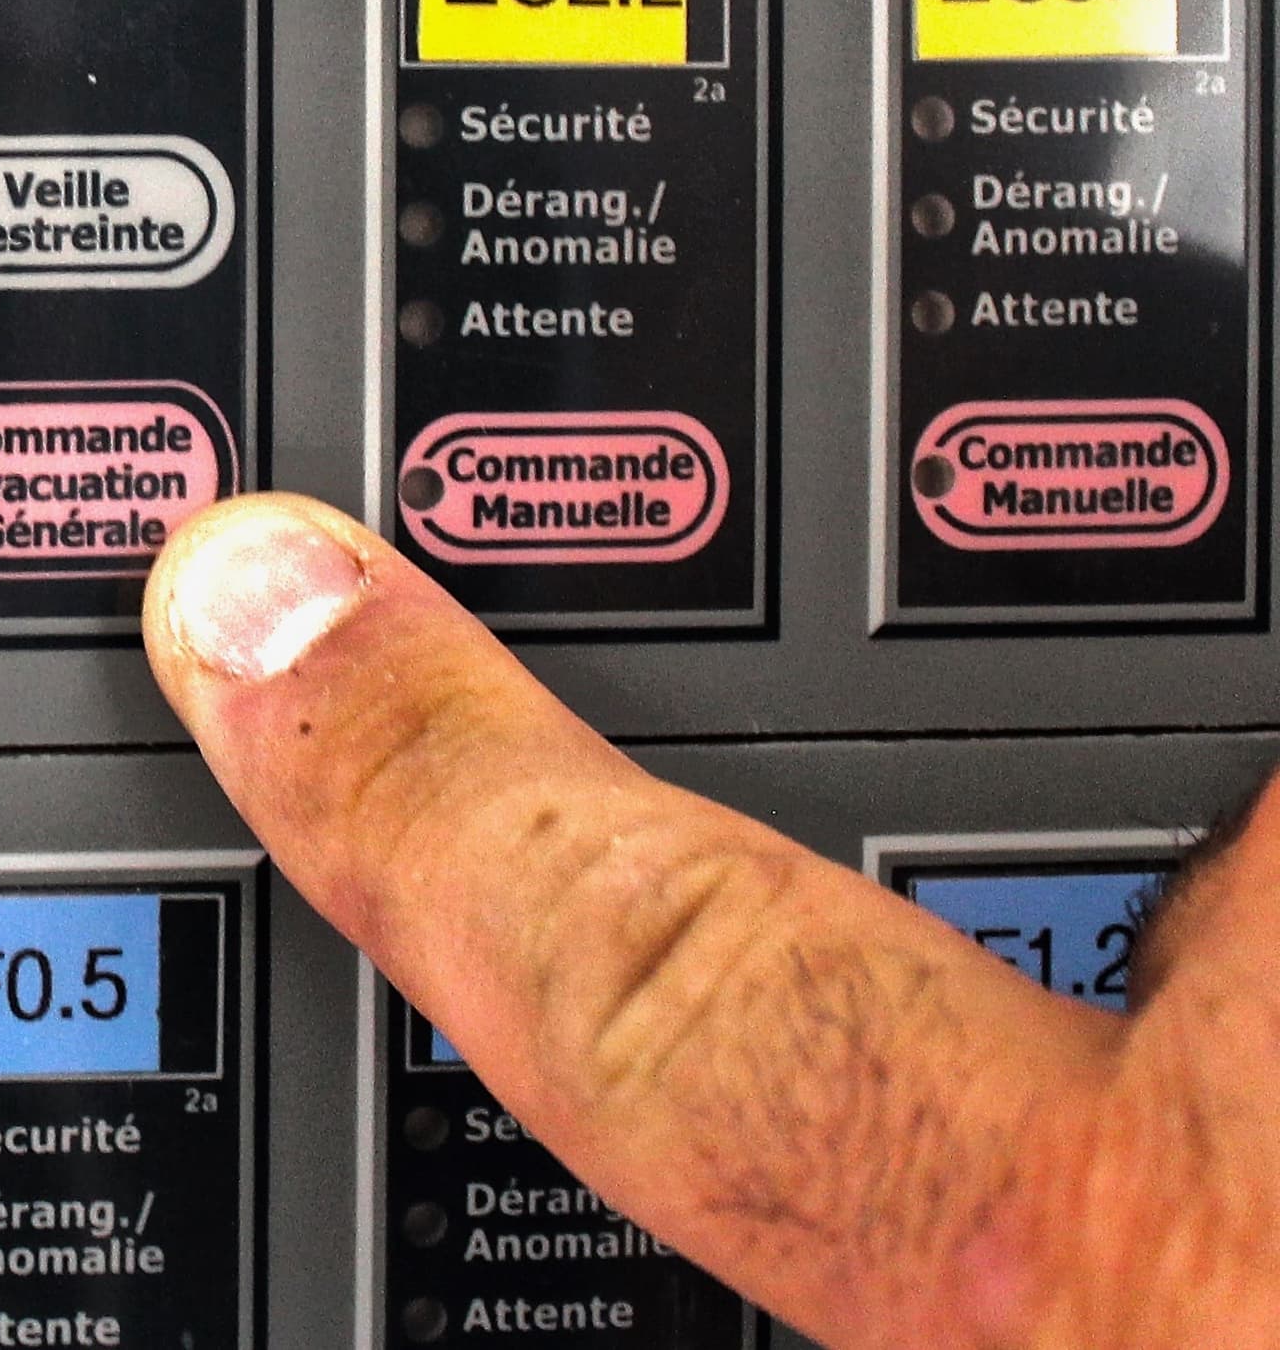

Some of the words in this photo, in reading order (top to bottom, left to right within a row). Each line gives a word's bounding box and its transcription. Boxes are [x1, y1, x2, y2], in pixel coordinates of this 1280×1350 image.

[694, 77, 725, 102] 2a
[1196, 71, 1226, 95] 2a
[462, 103, 651, 141] Sécurité
[972, 96, 1156, 135] Sécurité
[4, 171, 129, 208] Veille
[462, 228, 675, 263] Anomalie
[973, 220, 1180, 254] Anomalie
[462, 302, 633, 336] Attente
[972, 292, 1137, 325] Attente
[447, 446, 695, 482] Commande
[959, 433, 1198, 470] Commande
[473, 491, 670, 528] Manuelle
[983, 478, 1173, 516] Manuelle
[974, 923, 1136, 995] 1.2
[185, 1088, 217, 1112] 2a
[466, 1177, 624, 1221] Déran
[464, 1297, 633, 1331] Attente
